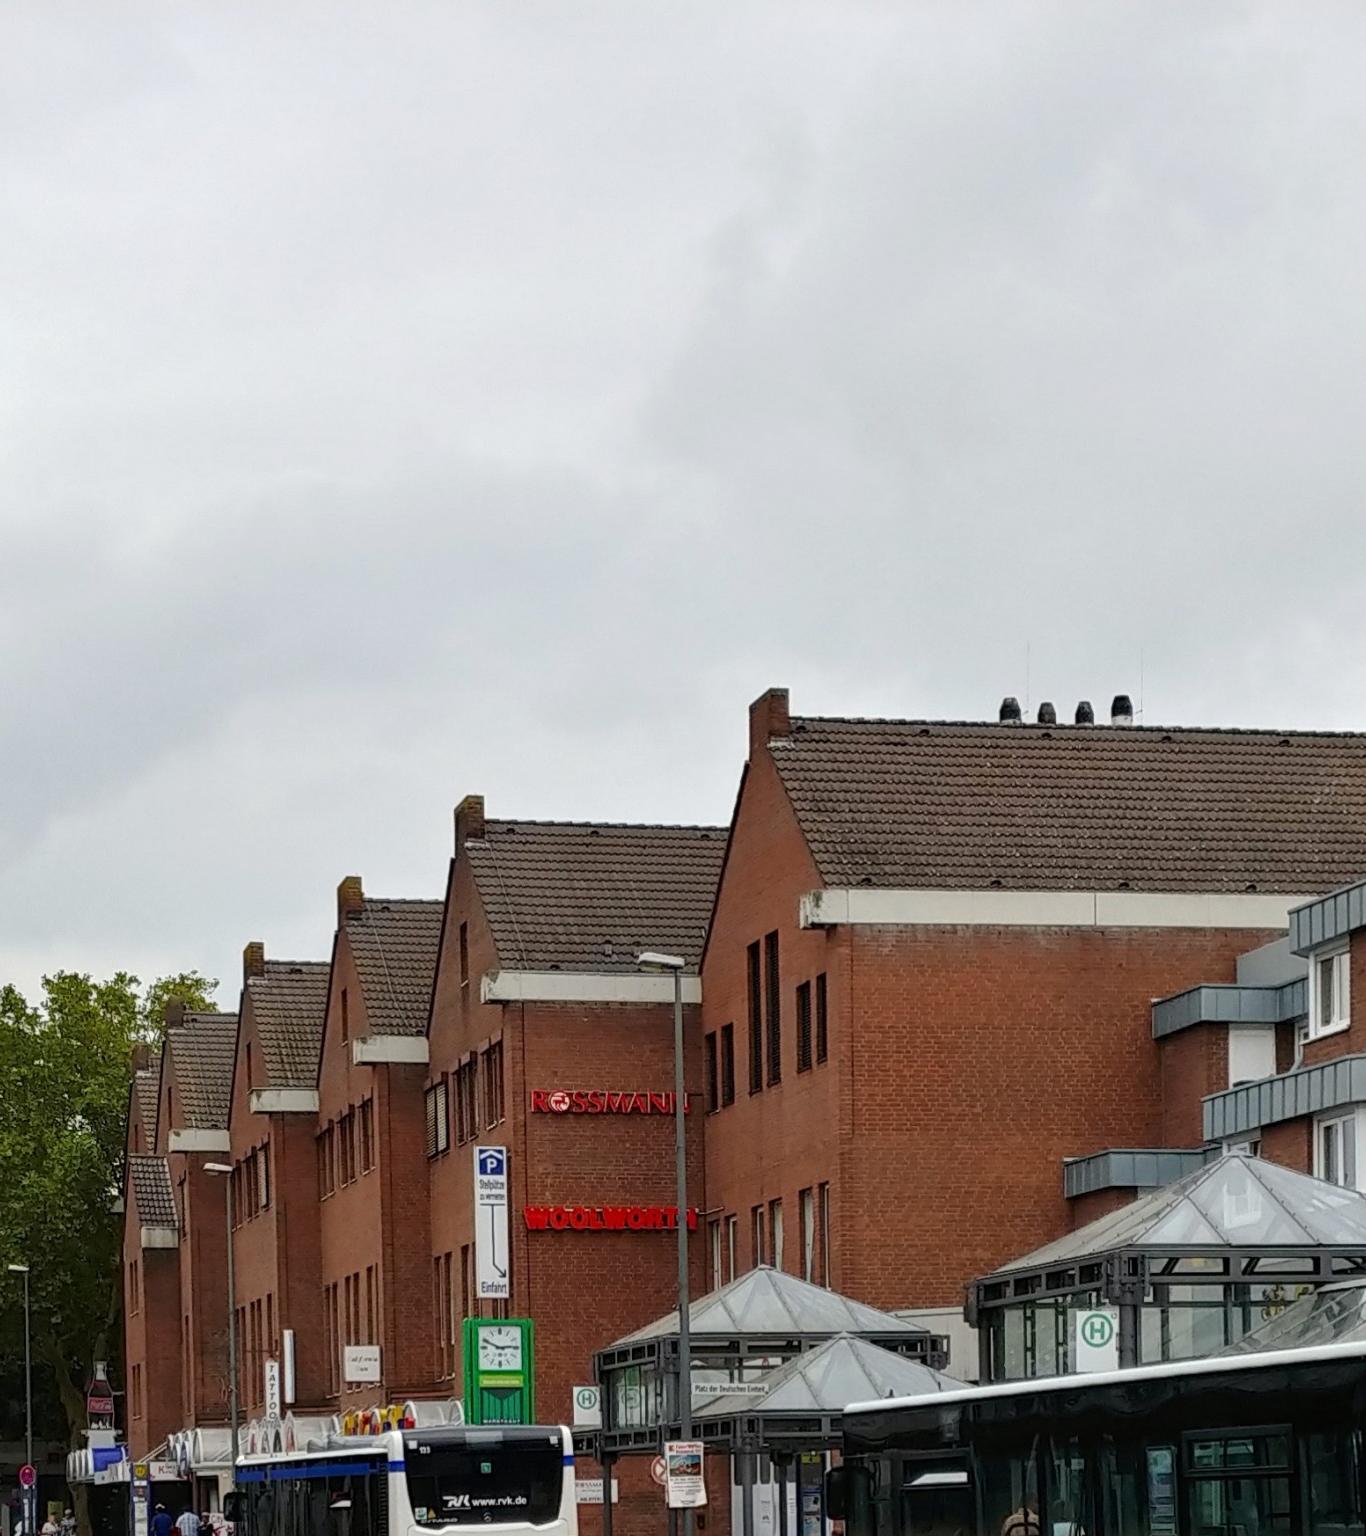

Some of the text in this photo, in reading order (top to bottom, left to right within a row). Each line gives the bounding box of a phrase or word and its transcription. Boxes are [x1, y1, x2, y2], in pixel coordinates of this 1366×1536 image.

[523, 1206, 698, 1230] WOOLWORTH
[481, 1281, 508, 1294] Einfahrt
[1090, 1321, 1105, 1340] H
[471, 1496, 528, 1507] www.rvk.de
